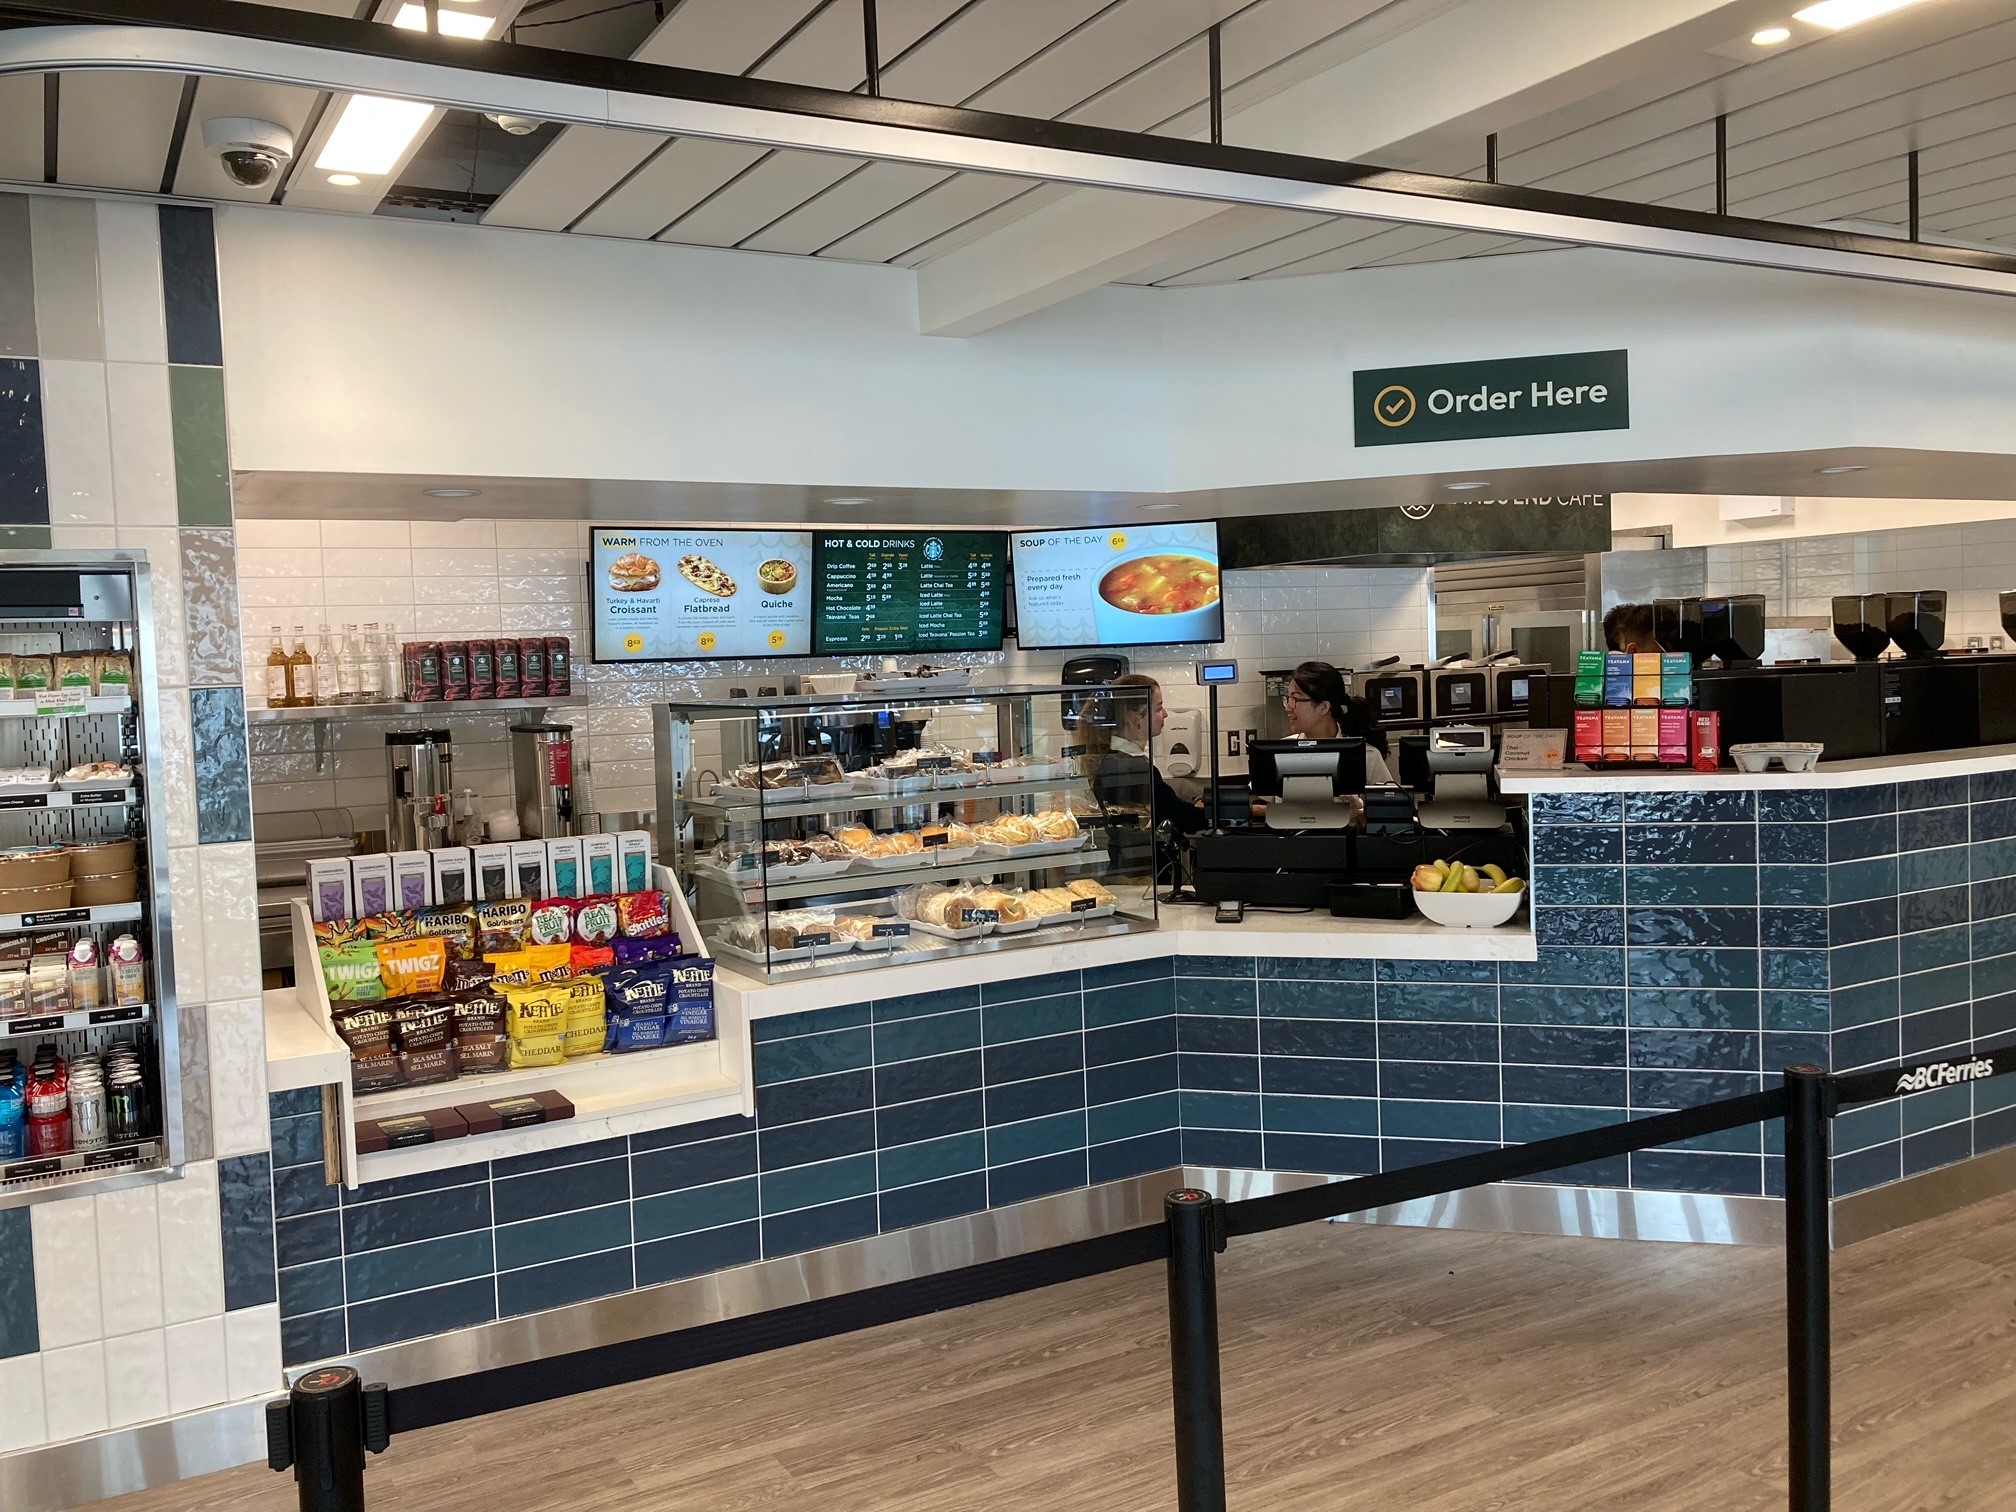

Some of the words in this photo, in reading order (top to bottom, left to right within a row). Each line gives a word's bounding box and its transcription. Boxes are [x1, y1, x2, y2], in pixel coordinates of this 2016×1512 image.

[1427, 385, 1522, 415] Order
[1531, 380, 1608, 408] Here
[602, 537, 636, 546] WARM
[640, 538, 670, 547] FROM
[673, 538, 693, 547] THE
[695, 538, 724, 547] OVEN
[824, 539, 845, 548] HOT
[846, 539, 853, 548] &
[855, 539, 880, 548] COLD
[882, 539, 916, 549] DRINKS
[1020, 538, 1046, 548] SOUP
[1047, 537, 1061, 546] OF
[1064, 536, 1082, 545] THE
[1084, 535, 1103, 544] DAY
[1027, 574, 1061, 583] Prepared
[1062, 573, 1081, 581] fresh
[1027, 584, 1048, 592] every
[606, 597, 628, 605] Turkey
[693, 596, 721, 604] Caprese
[761, 600, 794, 609] Quiche
[610, 605, 657, 614] Croissant
[684, 604, 730, 613] Flatbread
[482, 904, 526, 919] HARIBO
[584, 908, 610, 921] REAL
[425, 914, 470, 928] HARIBO
[535, 911, 562, 926] REAL
[585, 916, 612, 930] FRUIT
[537, 918, 564, 934] FRUIT
[628, 914, 669, 937] Skittles
[35, 931, 65, 944] CHOCOLAT
[428, 927, 467, 937] Goldbears
[386, 954, 441, 975] TWIGZ
[672, 968, 713, 984] KETTLE
[33, 987, 65, 1003] CHOCOLAT
[623, 983, 667, 1002] KETTLE
[453, 1001, 501, 1017] KETTLE
[519, 1002, 564, 1018] KETTLE
[632, 1007, 663, 1015] CROUSTILLES
[343, 1010, 393, 1031] KETTLE
[352, 1033, 374, 1041] POTATO
[374, 1029, 390, 1038] CHIPS
[360, 1025, 379, 1033] BRAND
[416, 1027, 435, 1035] BRAND
[353, 1035, 390, 1046] CROUSTILLES
[408, 1035, 429, 1043] POTATO
[428, 1031, 444, 1039] CHIPS
[409, 1036, 444, 1048] CROUSTILLES
[374, 1052, 391, 1061] SALT
[412, 1055, 425, 1063] SEA
[425, 1052, 443, 1061] SALT
[472, 1050, 495, 1058] MARIN
[357, 1062, 370, 1070] SEL
[371, 1059, 394, 1068] MARIN
[423, 1060, 447, 1069] MARIN
[1914, 1056, 1994, 1091] BCFerries
